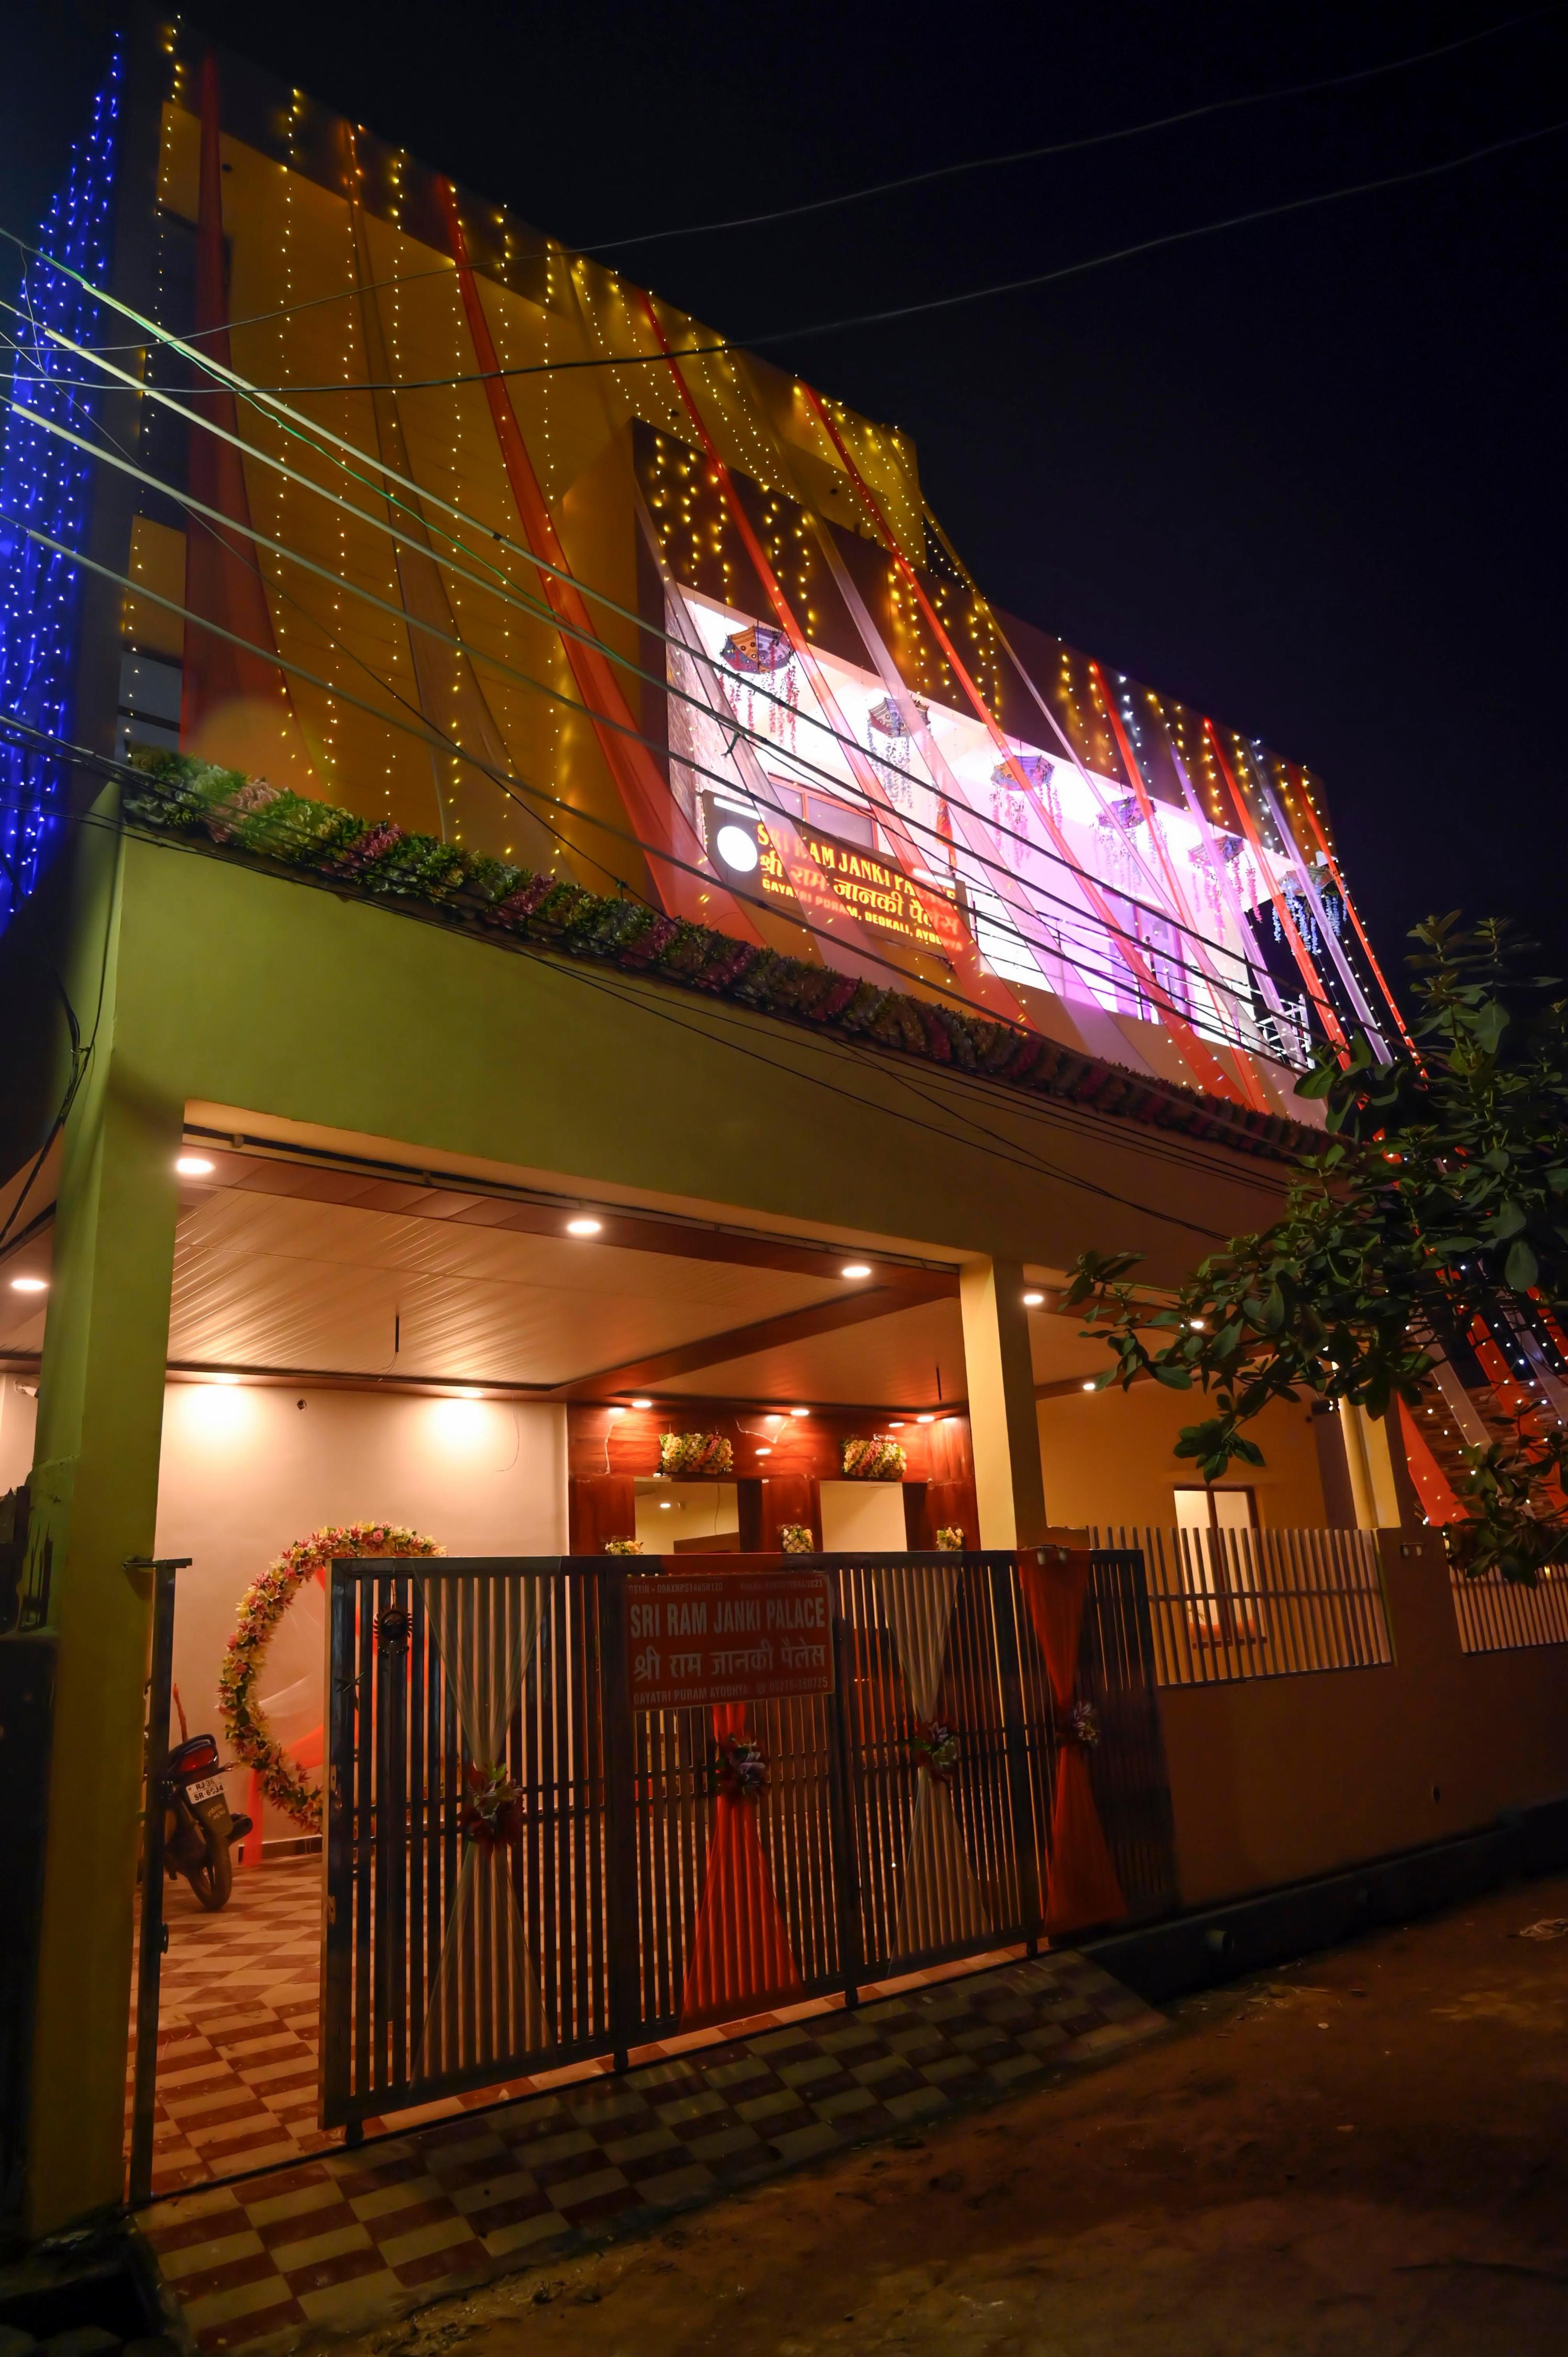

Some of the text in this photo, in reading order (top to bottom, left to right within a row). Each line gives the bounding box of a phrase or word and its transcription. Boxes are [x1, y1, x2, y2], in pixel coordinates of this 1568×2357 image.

[760, 850, 783, 877] श्री
[790, 864, 829, 891] राम
[834, 878, 904, 917] जानकी
[838, 852, 891, 887] JANKI
[894, 874, 956, 908] PAE
[865, 911, 913, 937] DEOKALI,
[630, 1596, 825, 1639] SRI RAM JANKI PALACE
[634, 1637, 826, 1682] श्री राम जानकी पैलेस
[633, 1690, 671, 1705] GAYATRI
[674, 1687, 708, 1701] PURAM
